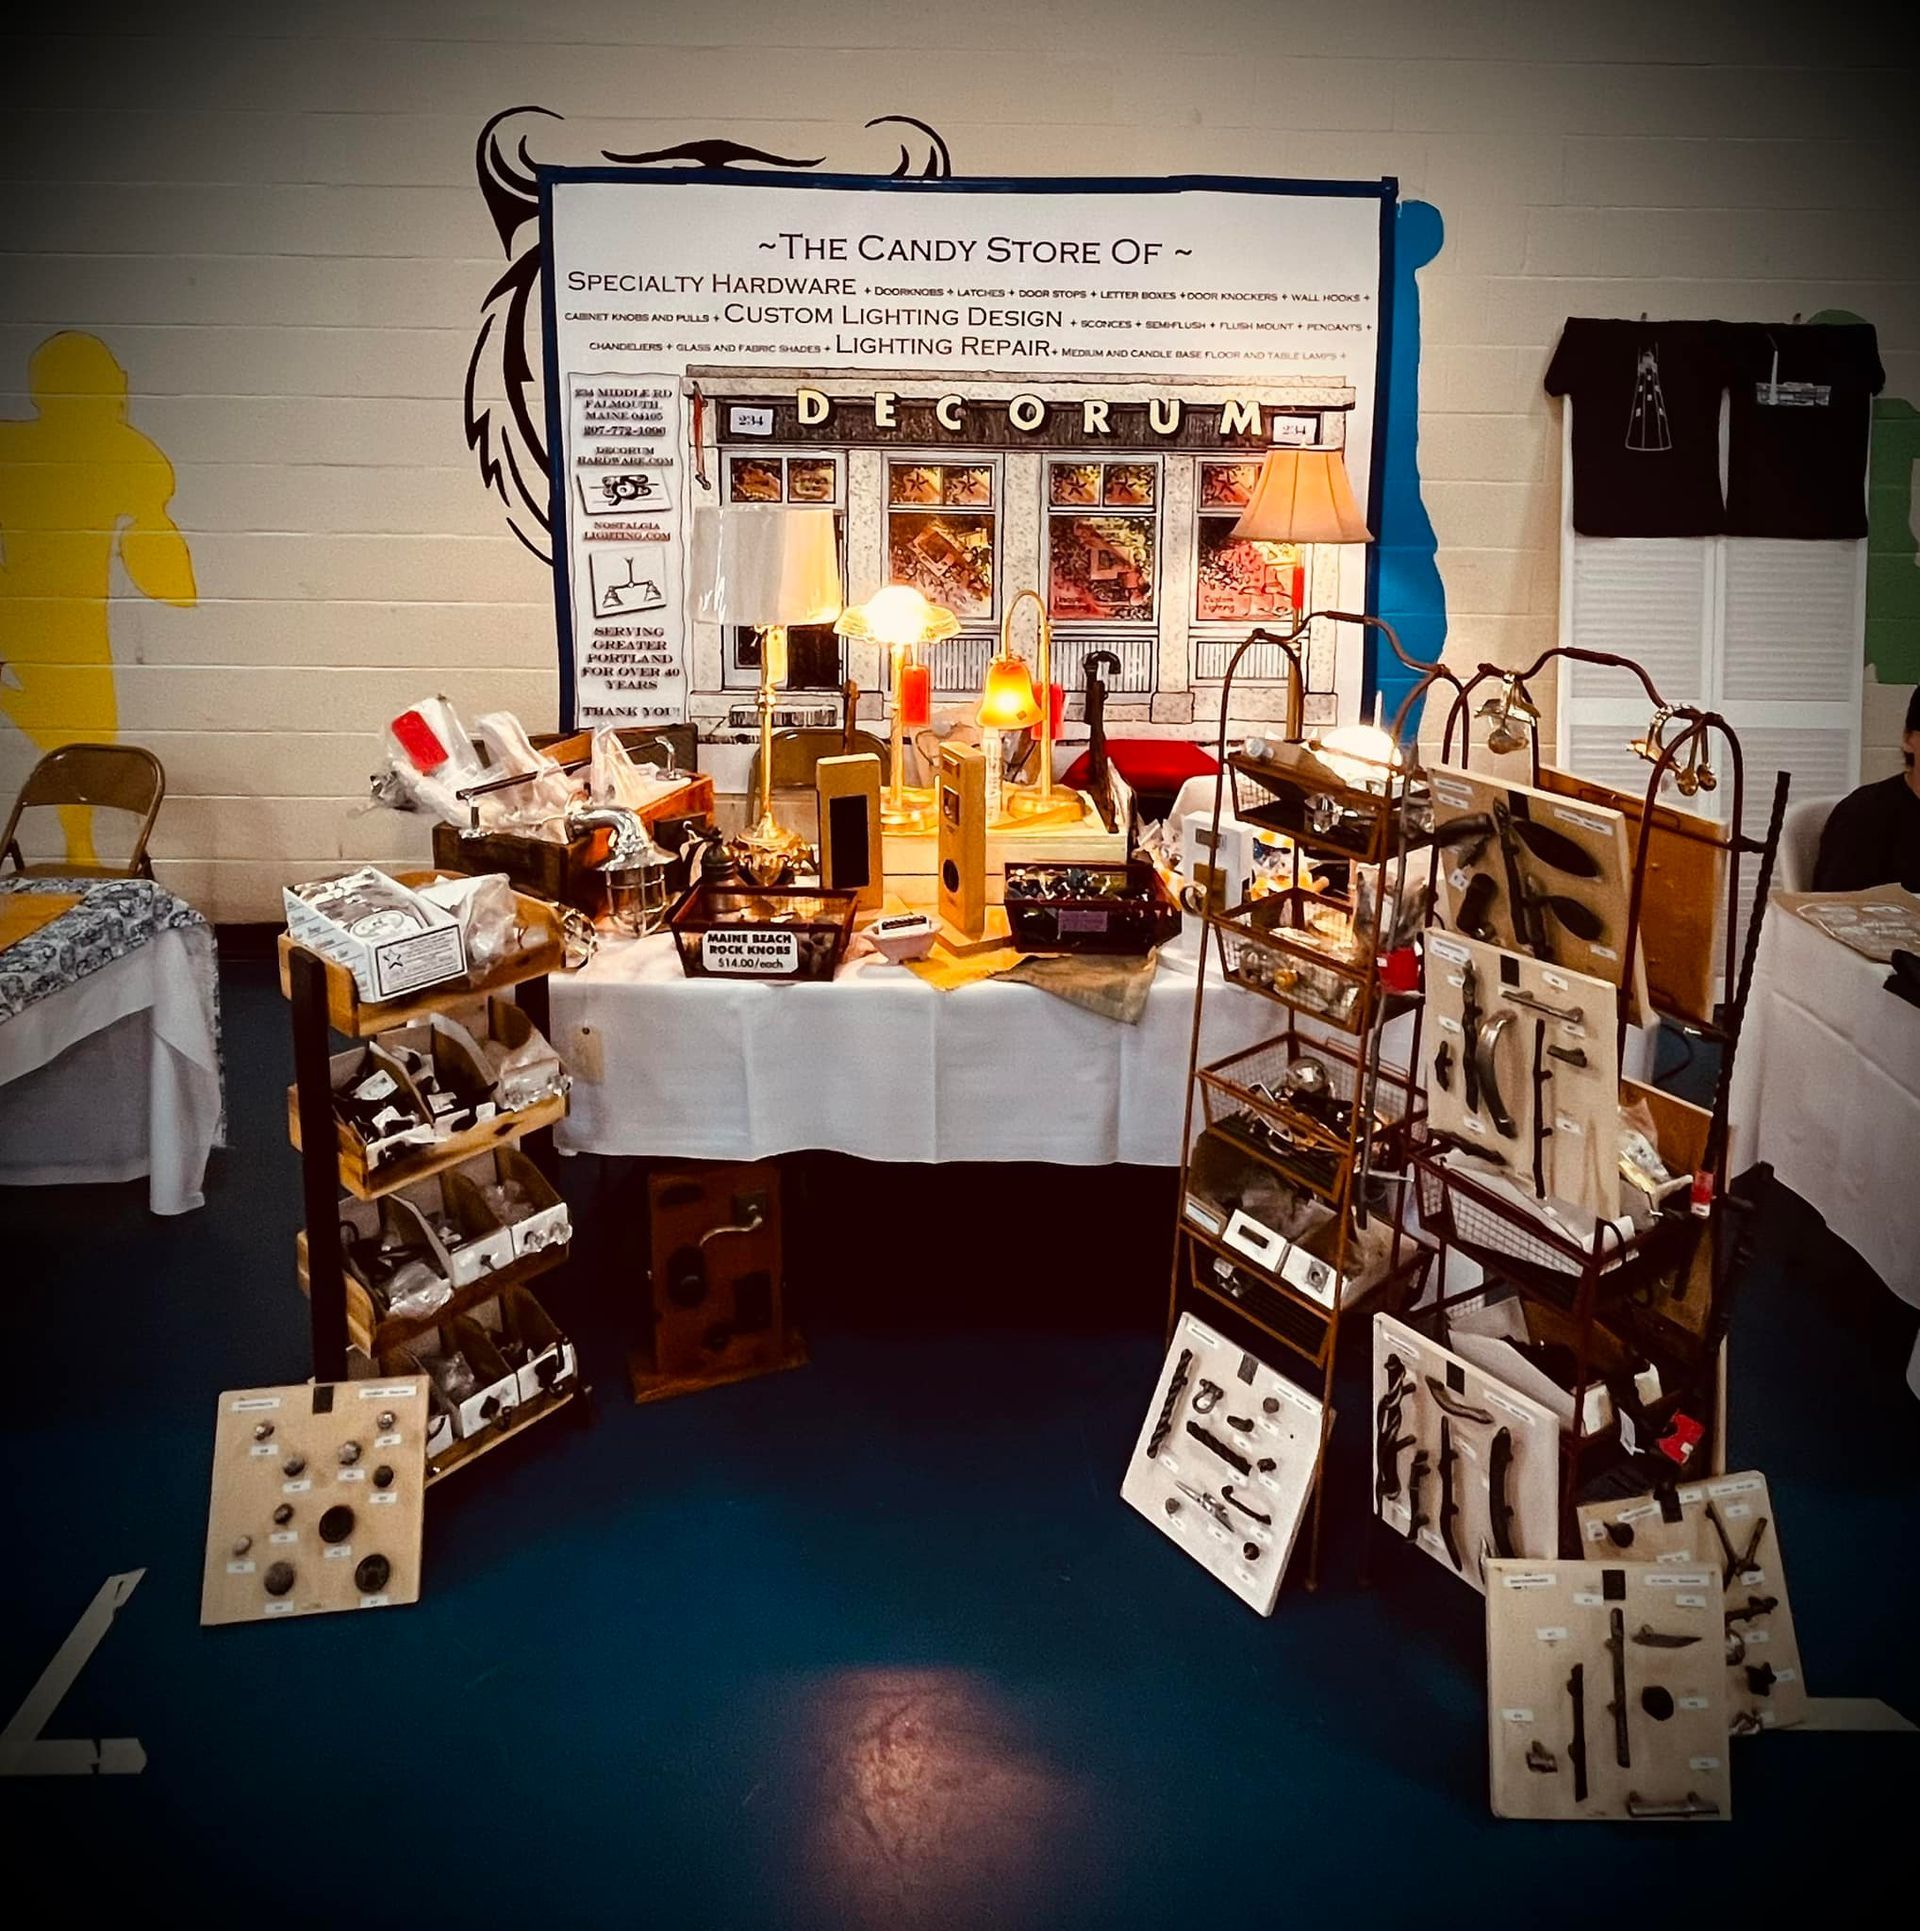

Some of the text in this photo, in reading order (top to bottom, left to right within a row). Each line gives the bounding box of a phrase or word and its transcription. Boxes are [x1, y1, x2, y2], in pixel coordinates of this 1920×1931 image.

[858, 234, 977, 263] CANDY
[987, 236, 1101, 264] STORE
[1112, 238, 1163, 264] OF
[567, 271, 856, 295] SPECIALTY HARDWARE
[875, 286, 1361, 302] DOORKNOBS LATCHES DOOR STOPS LETTER BOXES DOOR KNOCKERS WALL HOOKS
[564, 312, 710, 323] CABINET KNOBS AND PULLS
[724, 303, 1062, 327] CUSTOM LIGHTING DESIGN
[1081, 320, 1132, 330] SCONCES
[1220, 322, 1253, 331] FLUSH
[1255, 322, 1294, 331] MOUNT
[1306, 323, 1363, 332] PENDANTS
[589, 341, 821, 353] CHANDELIERS GLASS AND FABRIC SHADES
[836, 334, 1050, 357] LIGHTING REPAIR
[1061, 348, 1104, 358] MEDIUM
[1106, 349, 1128, 358] AND
[1130, 349, 1172, 359] CANDLE
[1175, 350, 1202, 359] BASE
[598, 388, 650, 398] MIDDLE
[652, 389, 673, 398] RD
[585, 412, 630, 421] MAINE
[796, 388, 1264, 437] DECORUM
[596, 446, 655, 455] DECORUM
[594, 521, 661, 530] NOSTALGIA
[593, 627, 664, 637] SERVING
[592, 640, 667, 650] GREATER
[587, 653, 674, 664] PORTLAND
[581, 667, 614, 677] FOR
[618, 667, 660, 677] OVER
[605, 680, 658, 690] YEARS
[582, 706, 637, 717] THANK
[707, 933, 792, 945] MAINE BEACH
[709, 945, 791, 955] ROCK KNOBS
[718, 957, 784, 970] $14.00/each
